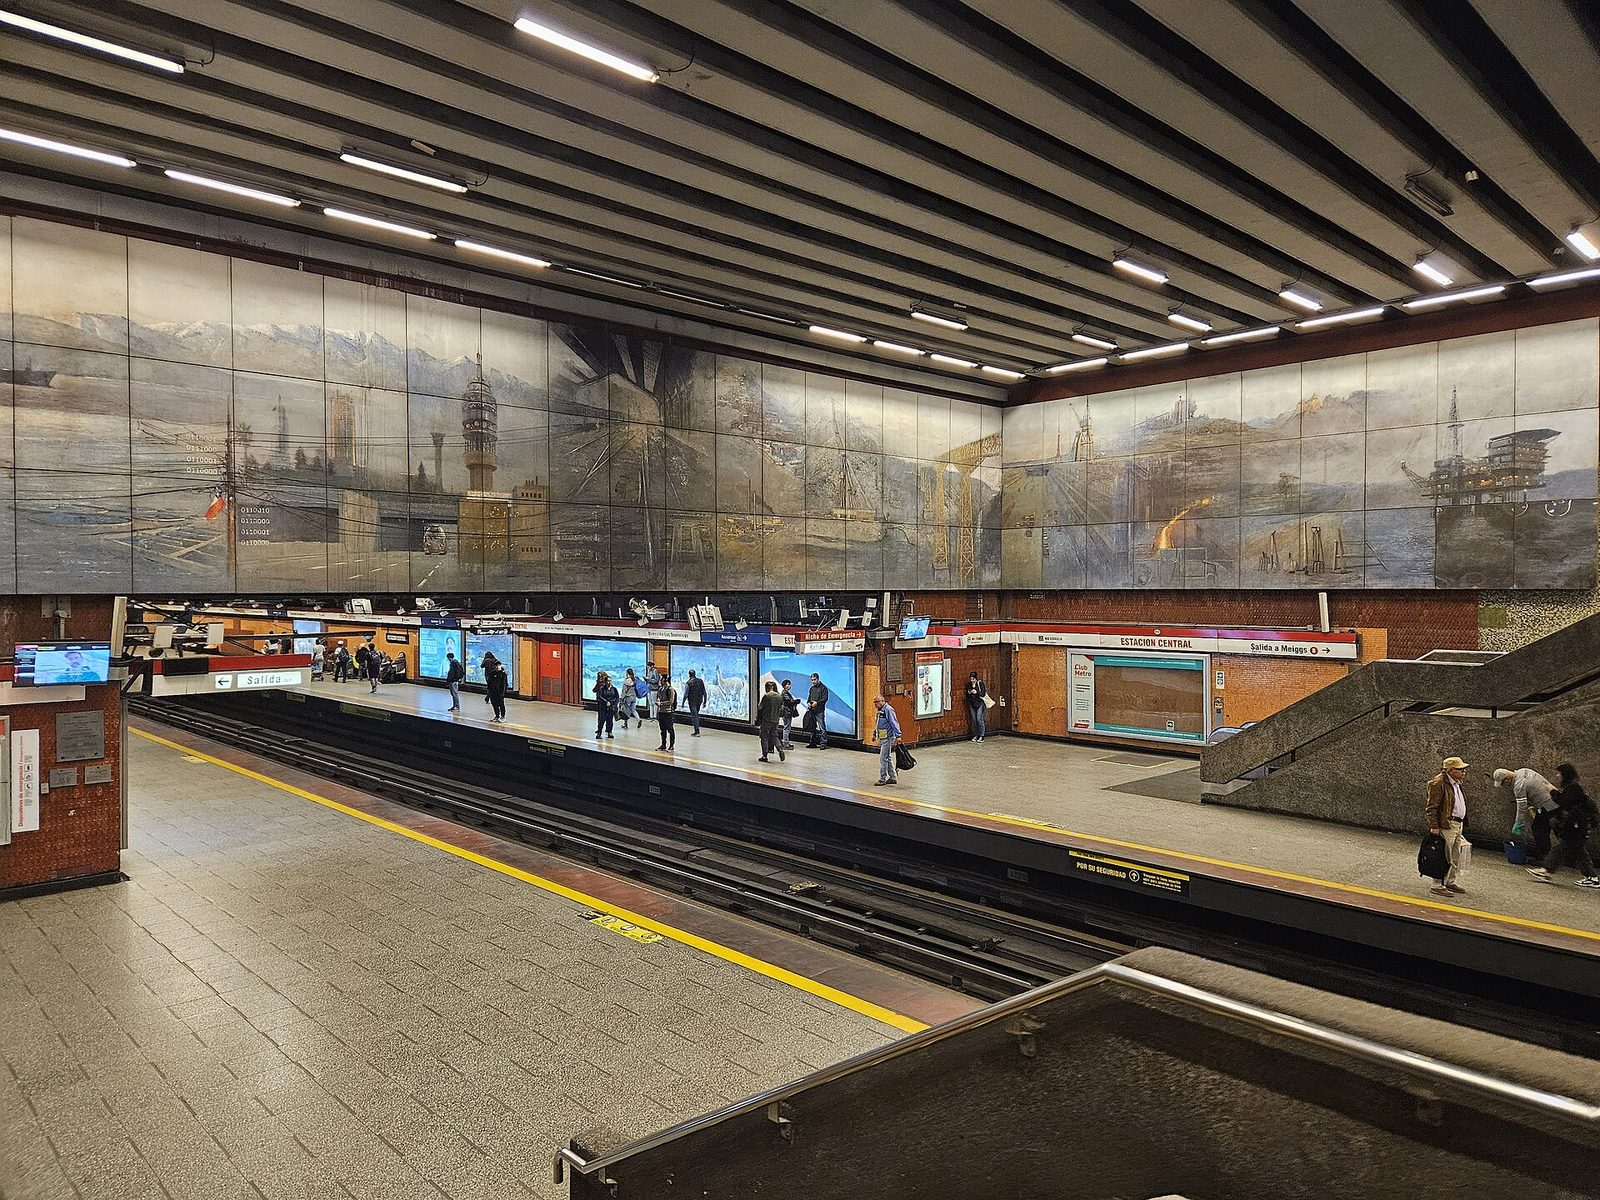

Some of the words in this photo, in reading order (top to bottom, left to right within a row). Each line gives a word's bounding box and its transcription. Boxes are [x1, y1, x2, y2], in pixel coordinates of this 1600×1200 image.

[1120, 637, 1156, 647] ESTACION
[1158, 638, 1193, 648] CENTRAL
[1250, 642, 1273, 652] Salida
[1281, 645, 1308, 654] Meiggs
[247, 675, 281, 685] Salida
[1076, 861, 1088, 870] POR
[1088, 864, 1096, 872] SU
[1096, 866, 1127, 879] SEGURIDAD
